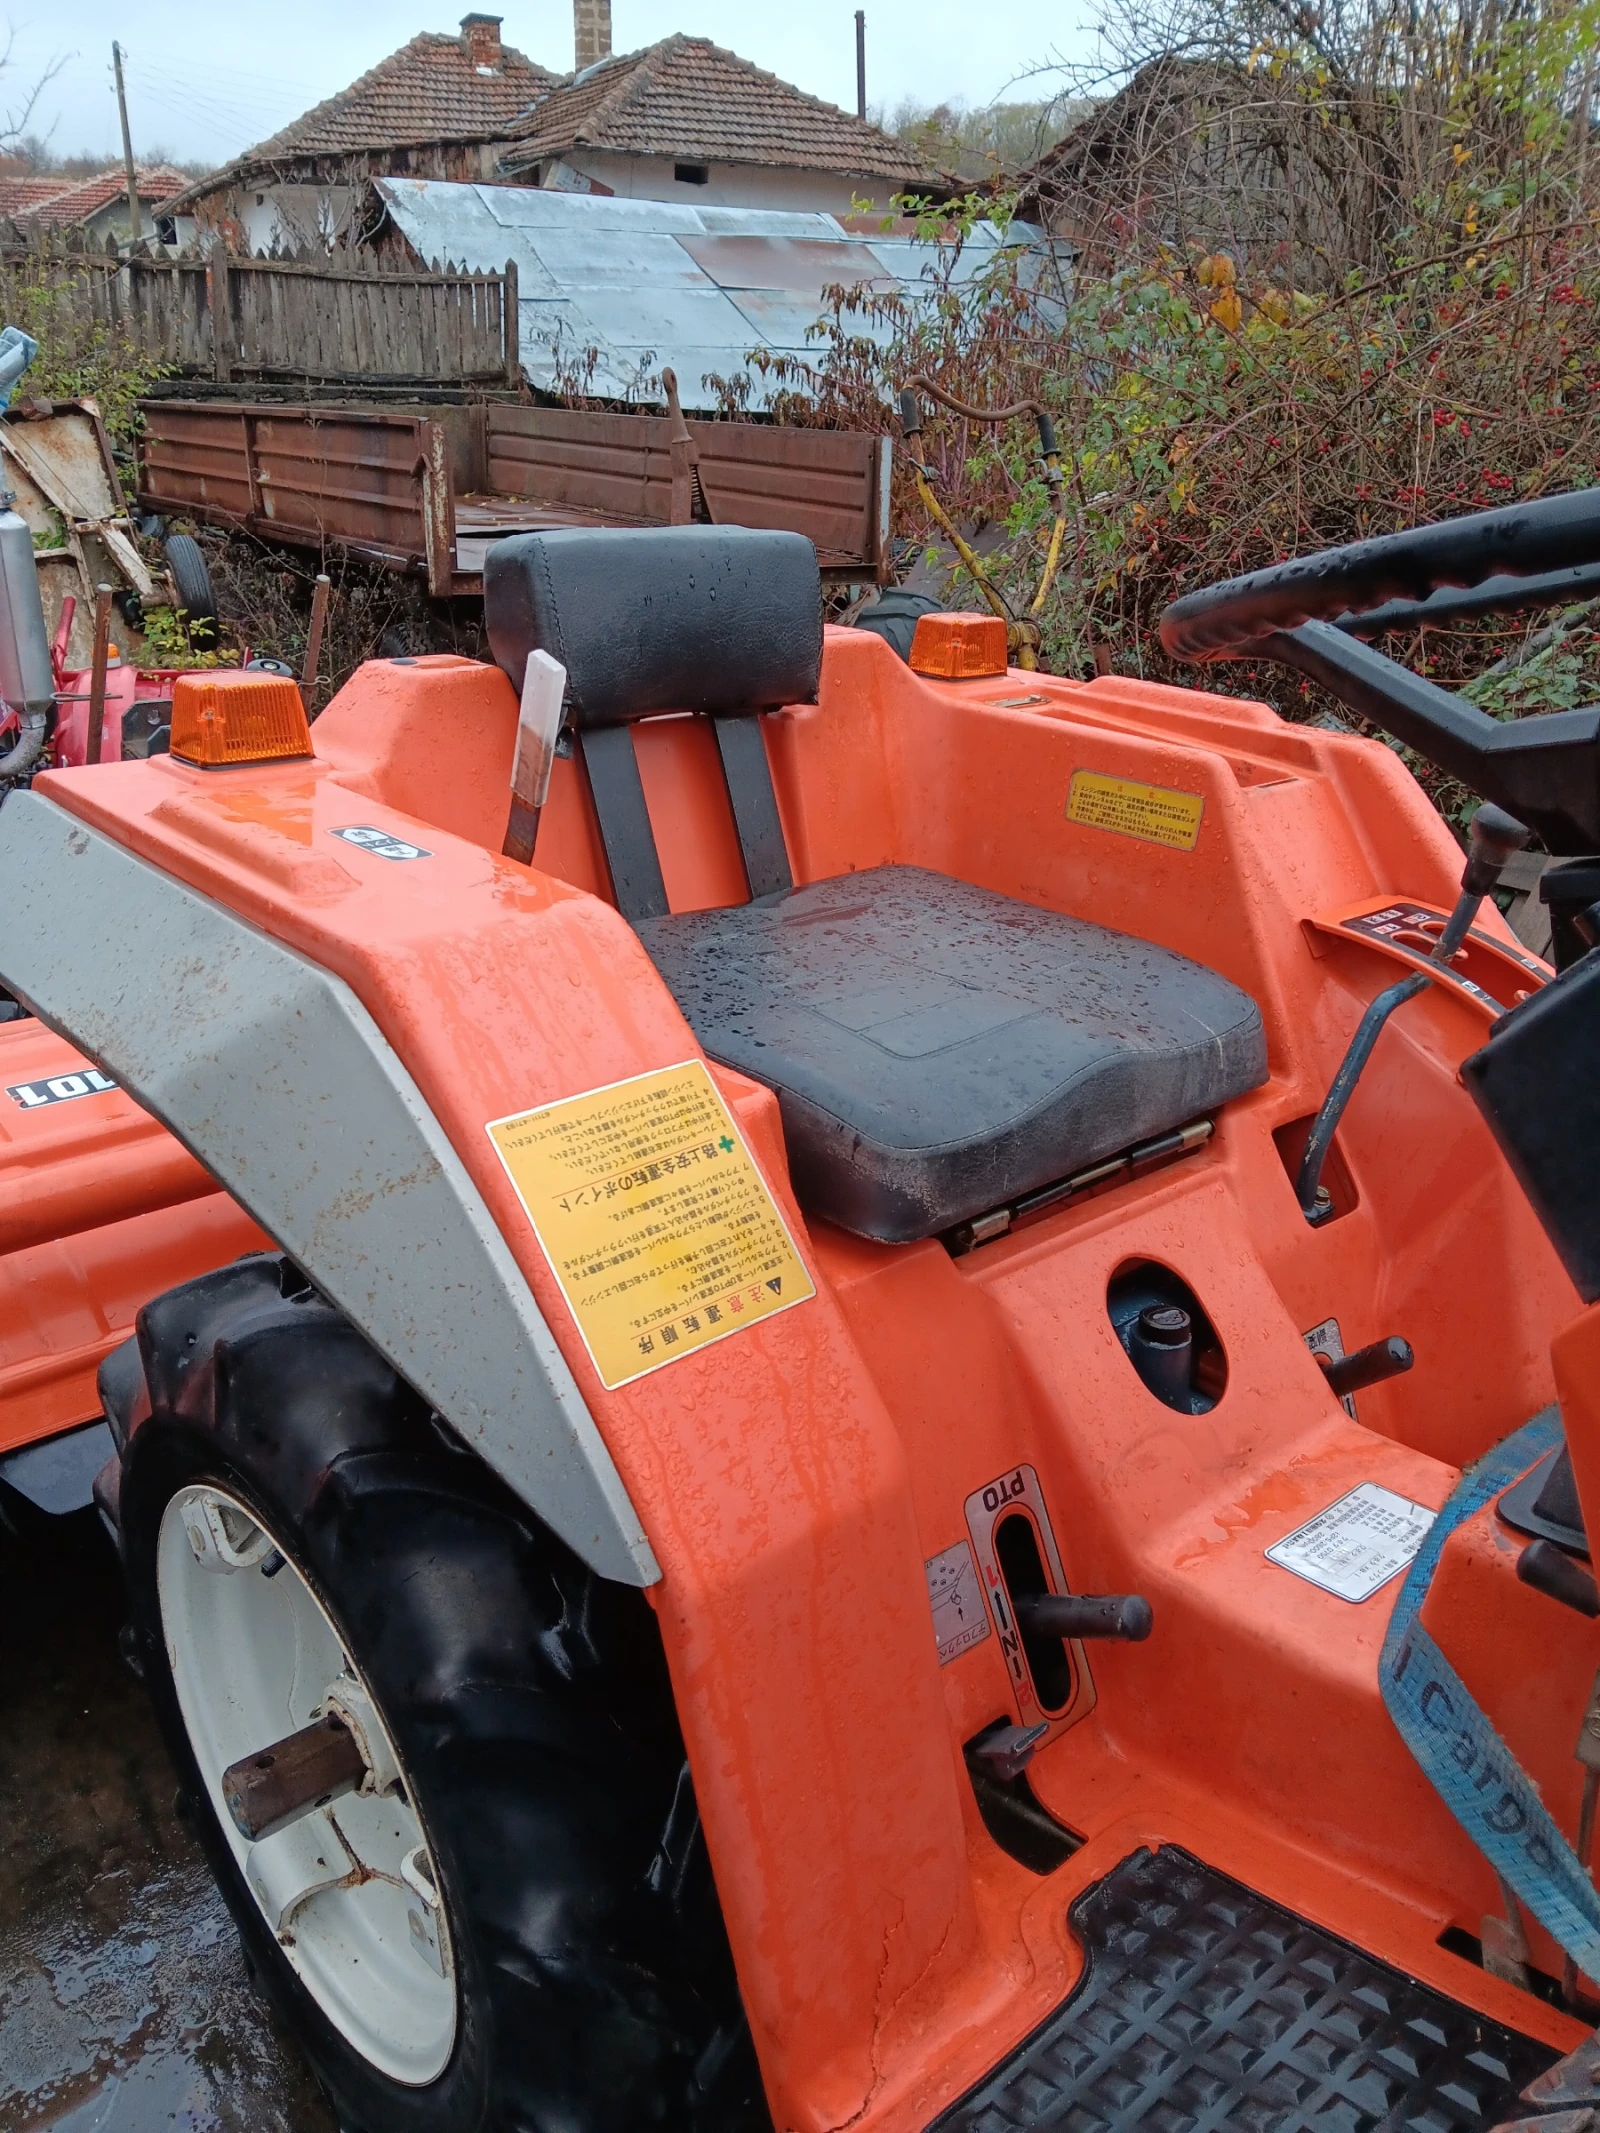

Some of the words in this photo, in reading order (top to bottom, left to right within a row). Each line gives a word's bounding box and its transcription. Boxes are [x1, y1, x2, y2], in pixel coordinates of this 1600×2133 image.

[556, 1141, 718, 1214] 路上安全運転のポイント
[983, 1471, 1025, 1512] PTO
[985, 1565, 1000, 1590] 1
[1002, 1635, 1018, 1658] N
[1015, 1685, 1032, 1708] 2
